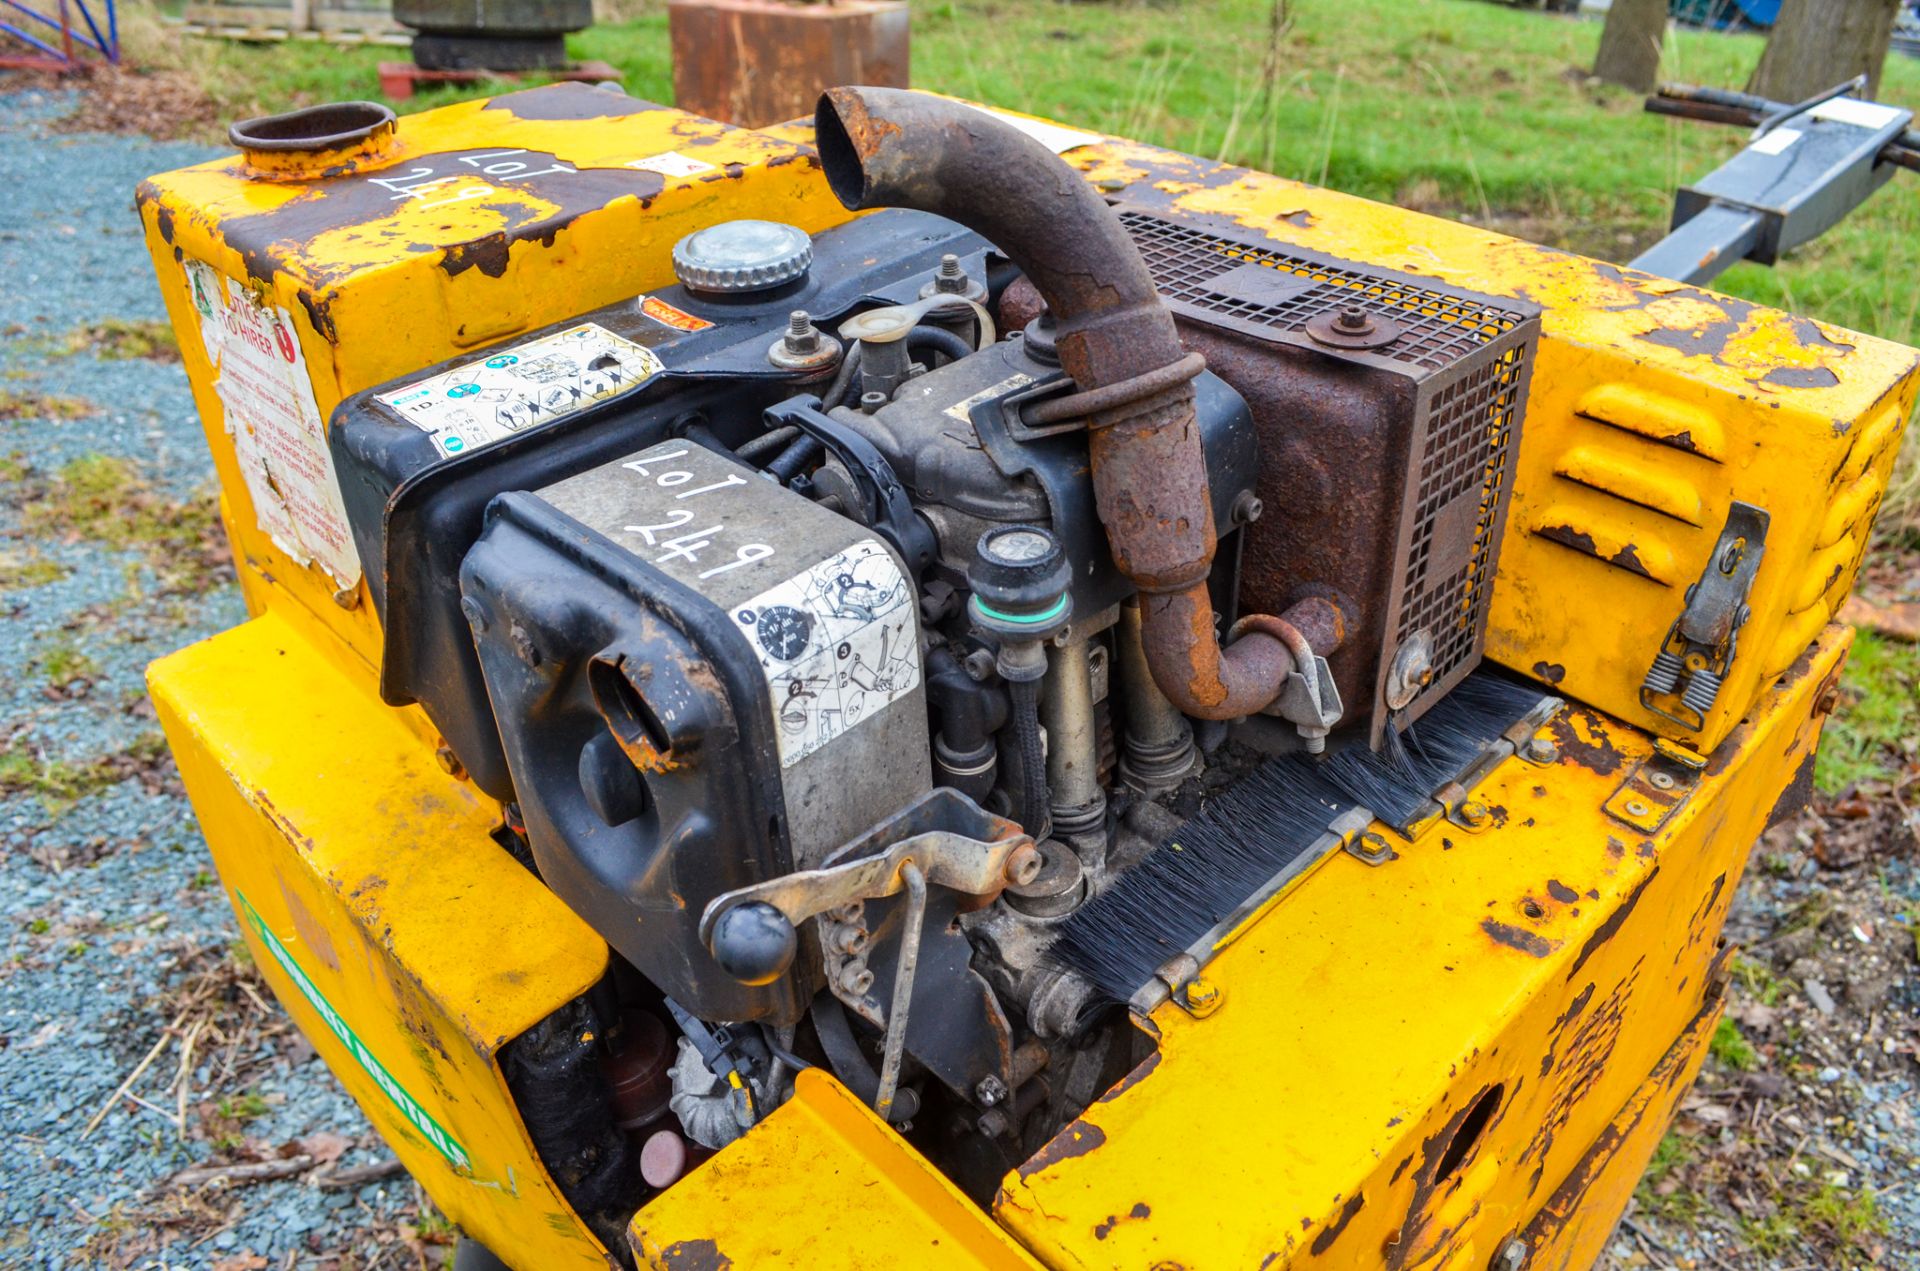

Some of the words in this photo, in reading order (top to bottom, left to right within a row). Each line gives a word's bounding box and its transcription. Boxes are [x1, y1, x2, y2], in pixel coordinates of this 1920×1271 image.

[458, 149, 577, 181] LOT
[367, 167, 495, 209] 249
[220, 309, 238, 335] TO
[238, 321, 276, 360] HIRER
[622, 450, 747, 499] LOT
[623, 509, 775, 579] 249
[848, 703, 861, 716] 5x
